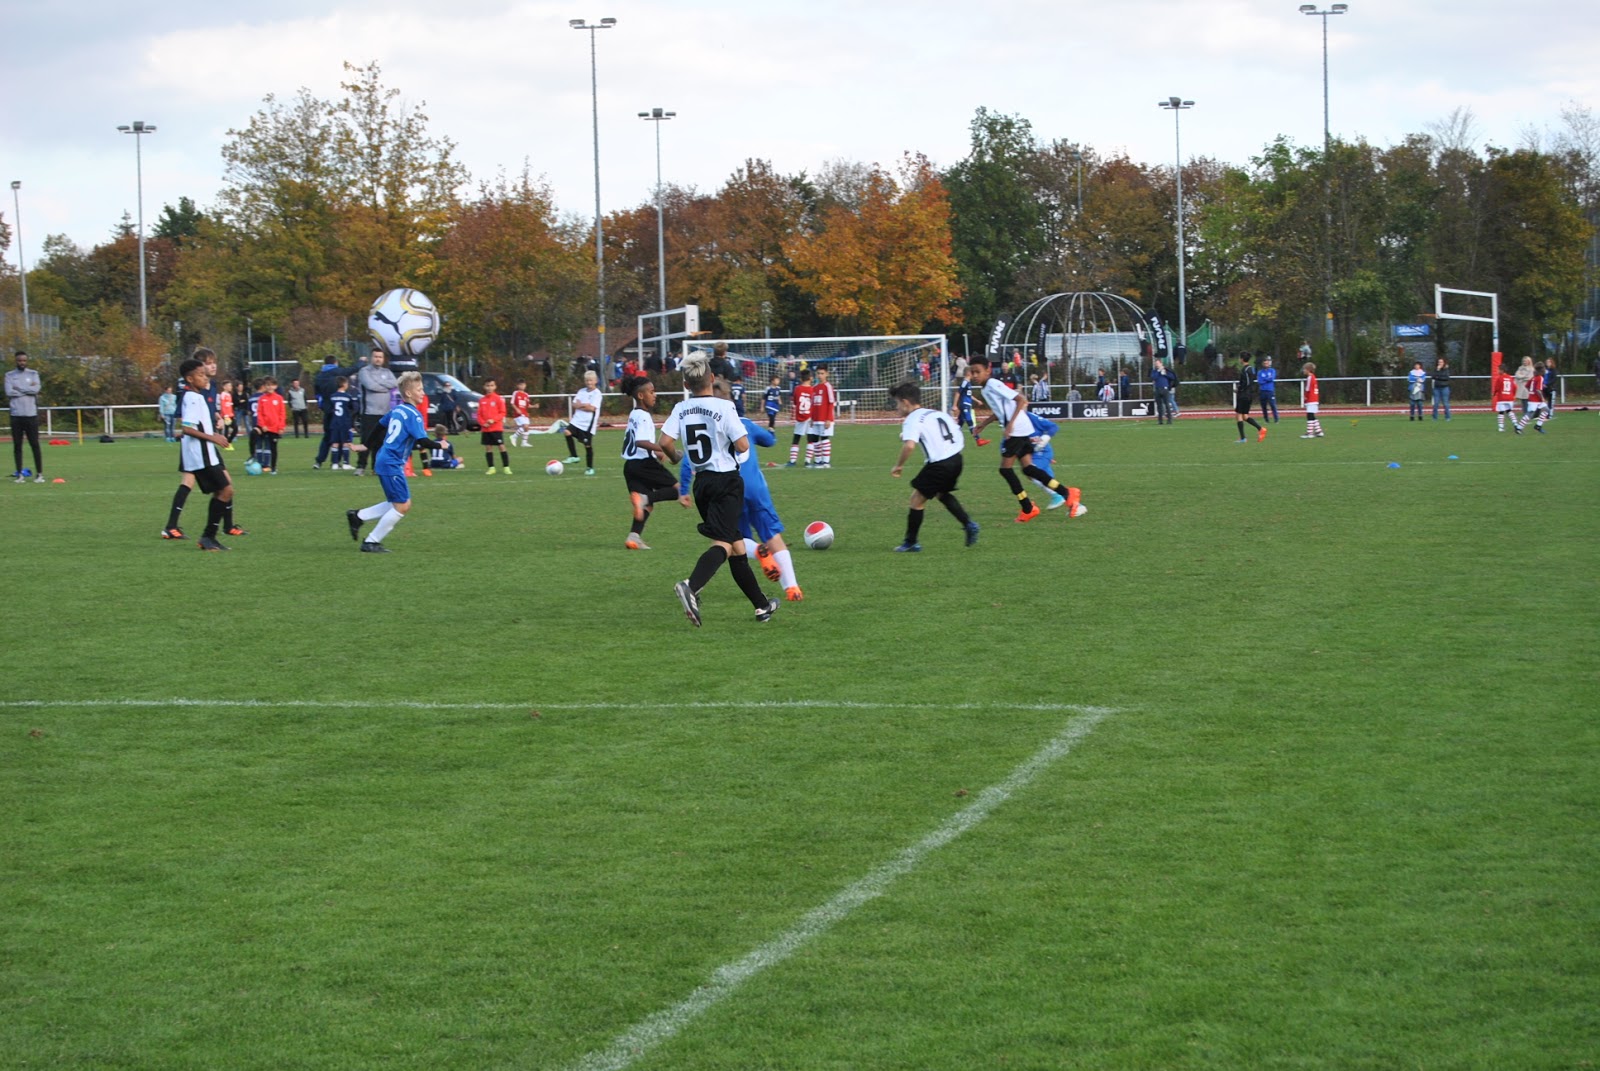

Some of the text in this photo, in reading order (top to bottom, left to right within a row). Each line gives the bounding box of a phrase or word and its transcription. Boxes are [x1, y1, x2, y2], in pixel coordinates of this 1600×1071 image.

[334, 401, 345, 417] 5
[385, 418, 402, 444] 9
[936, 417, 956, 444] 4
[685, 423, 713, 465] 5
